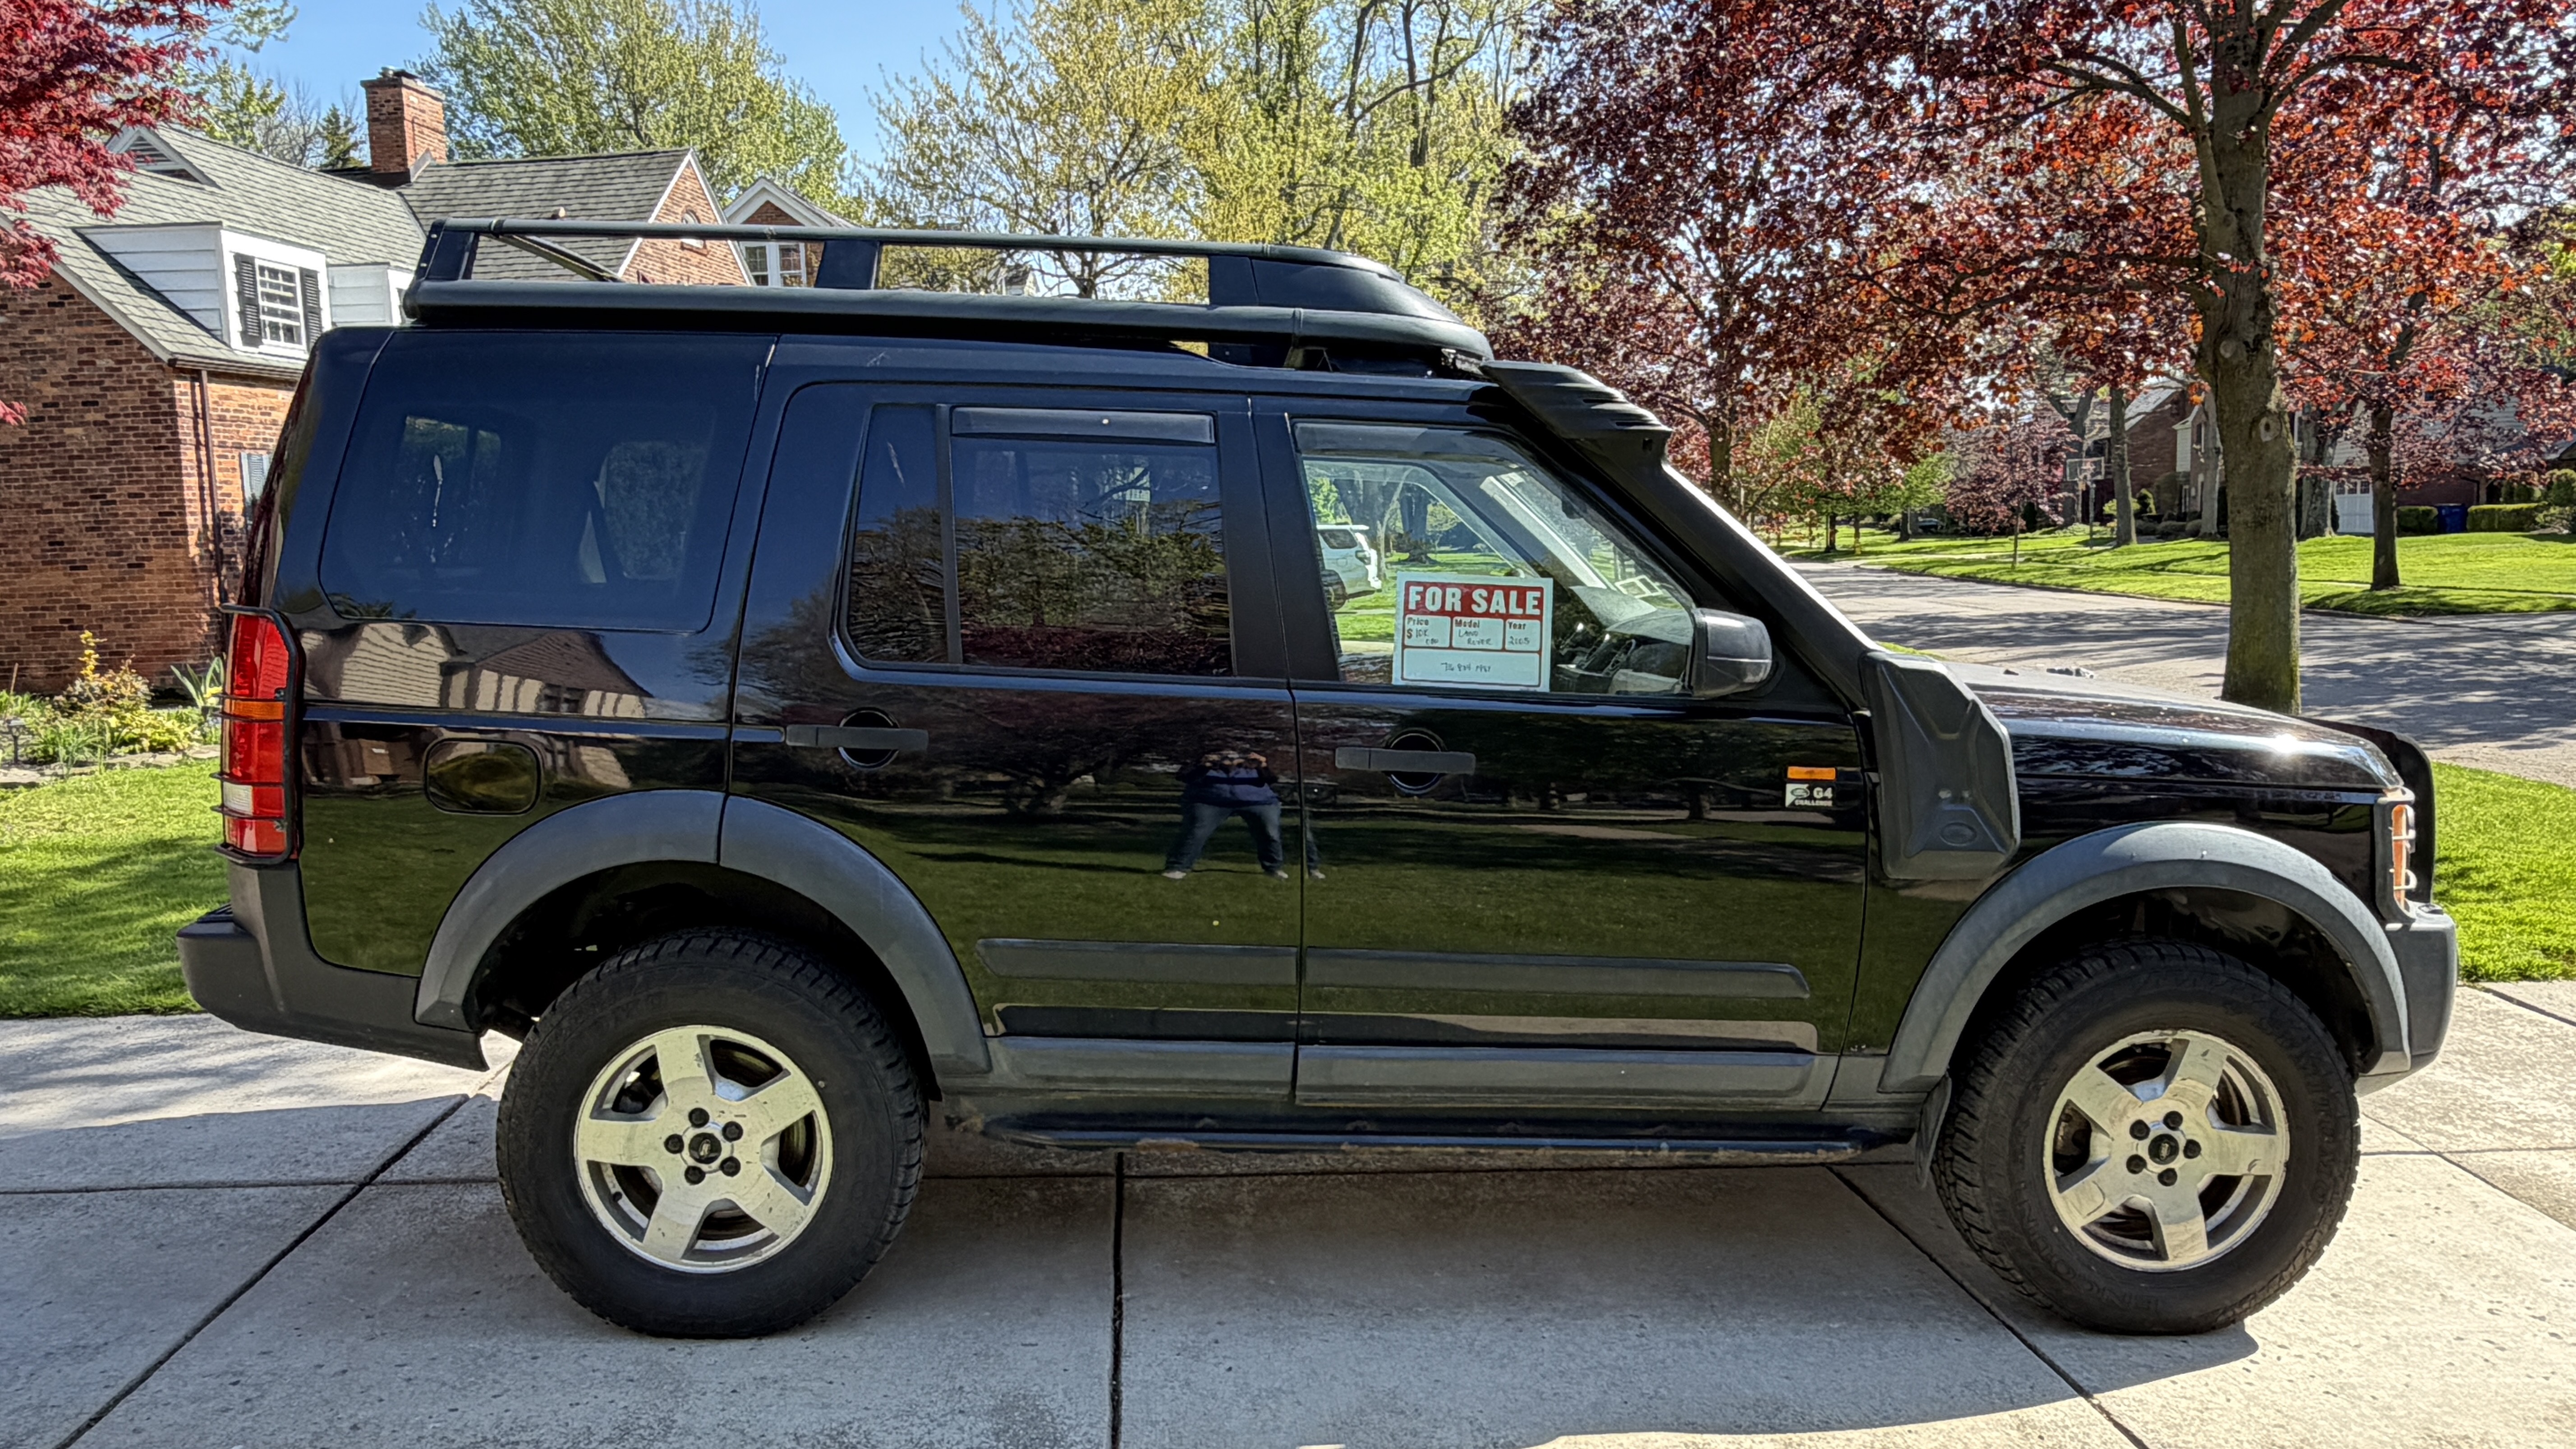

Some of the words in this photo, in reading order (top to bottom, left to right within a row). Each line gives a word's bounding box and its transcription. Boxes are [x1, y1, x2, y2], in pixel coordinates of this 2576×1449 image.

[1408, 586, 1462, 612] FOR
[1471, 589, 1541, 615] SALE
[1407, 617, 1429, 626] Price
[1454, 619, 1480, 628] Model
[1508, 621, 1527, 630] Year
[1406, 628, 1413, 639] $
[1813, 787, 1833, 799] G4
